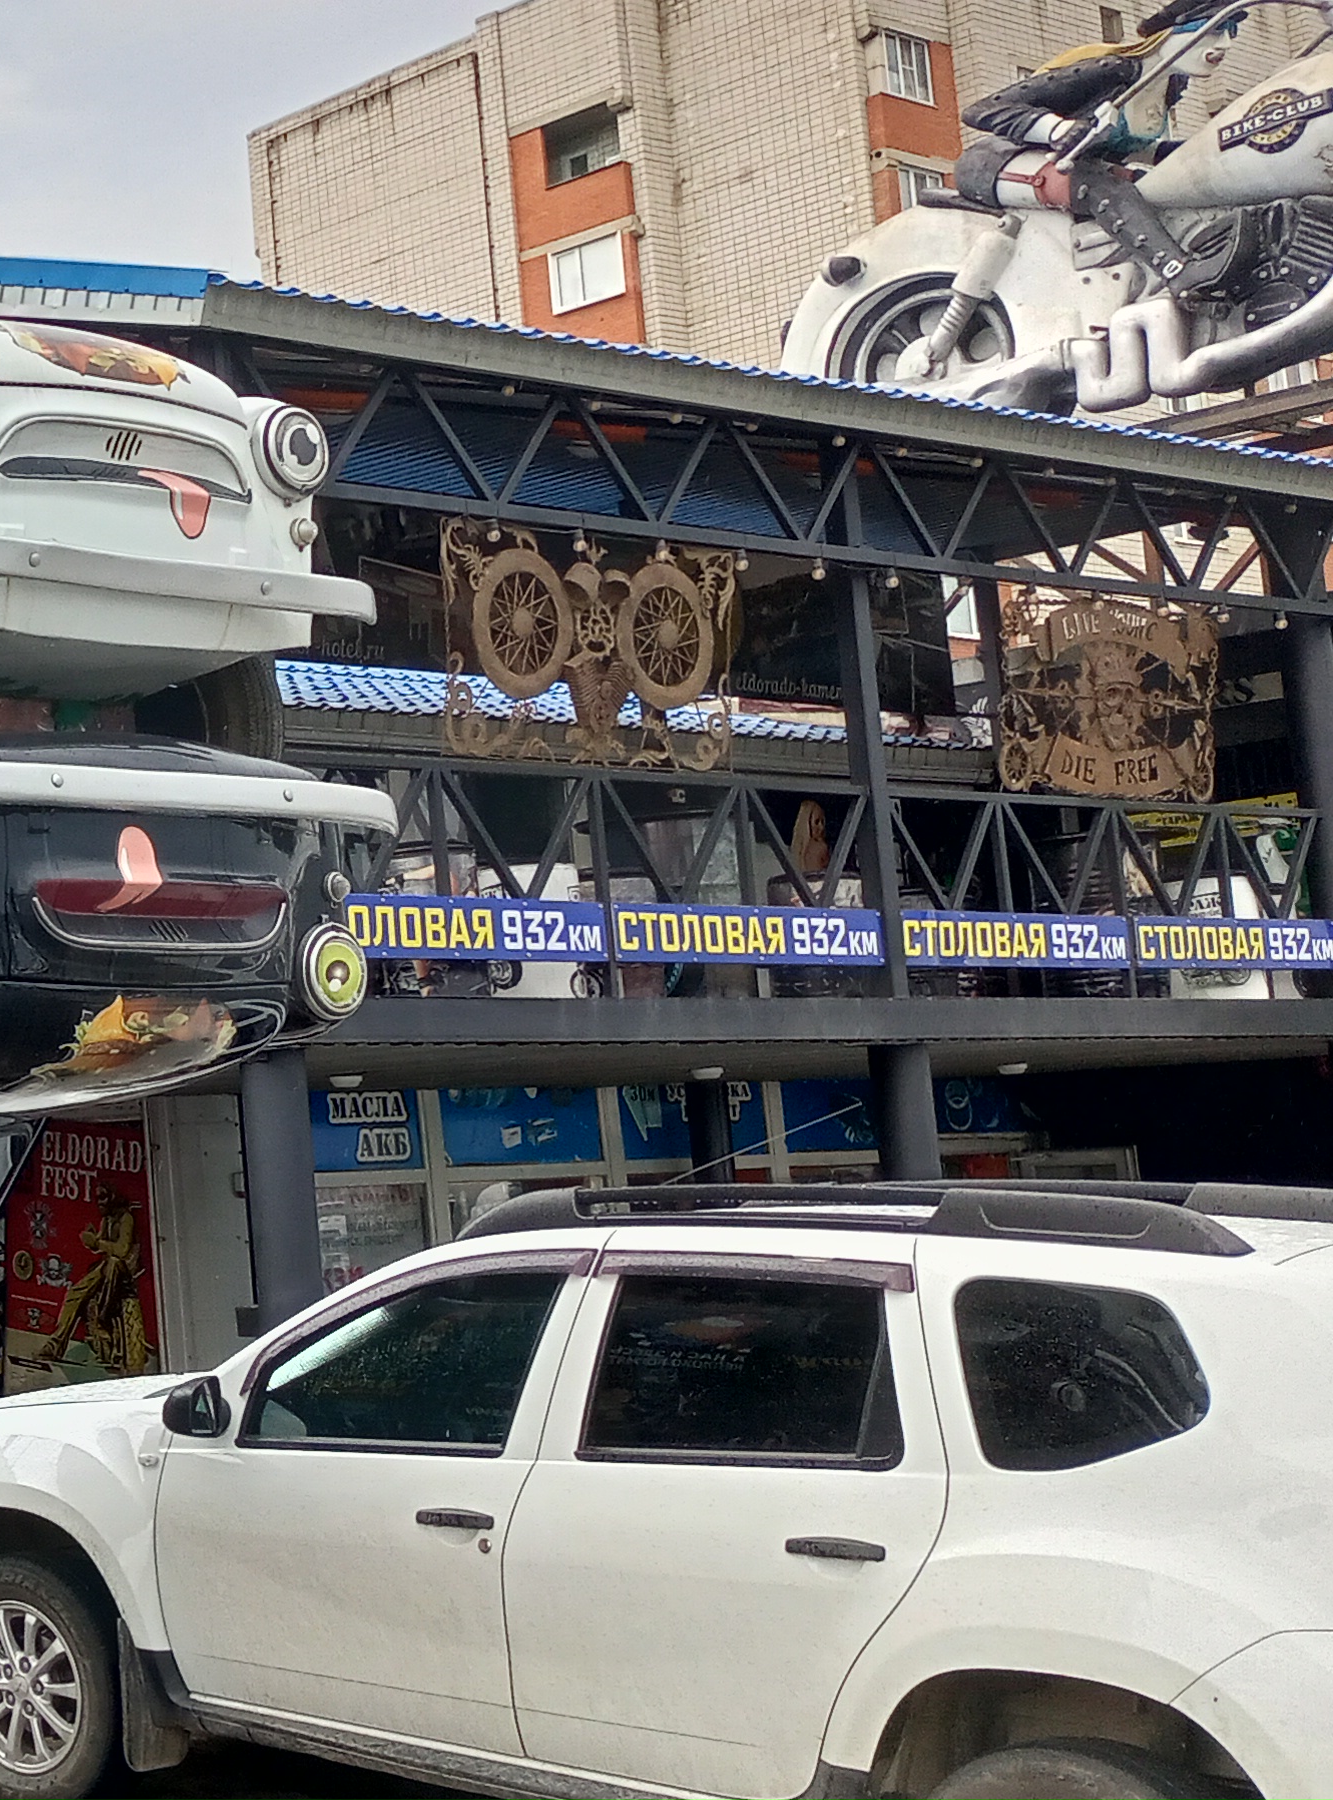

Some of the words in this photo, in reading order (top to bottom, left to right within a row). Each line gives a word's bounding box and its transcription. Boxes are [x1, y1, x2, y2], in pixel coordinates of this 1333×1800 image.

[1221, 96, 1323, 141] BIKE-CLUB
[1061, 751, 1097, 786] DIE
[347, 904, 496, 951] ОЛОВАЯ
[617, 911, 787, 956] СТОЛОВАЯ
[902, 919, 1047, 958] СТОЛОВАЯ
[1138, 925, 1265, 961] СТОЛОВАЯ
[329, 1095, 406, 1120] МАСЛА
[41, 1130, 144, 1174] ELDORAD
[359, 1131, 409, 1158] АКБ
[40, 1165, 98, 1203] FEST
